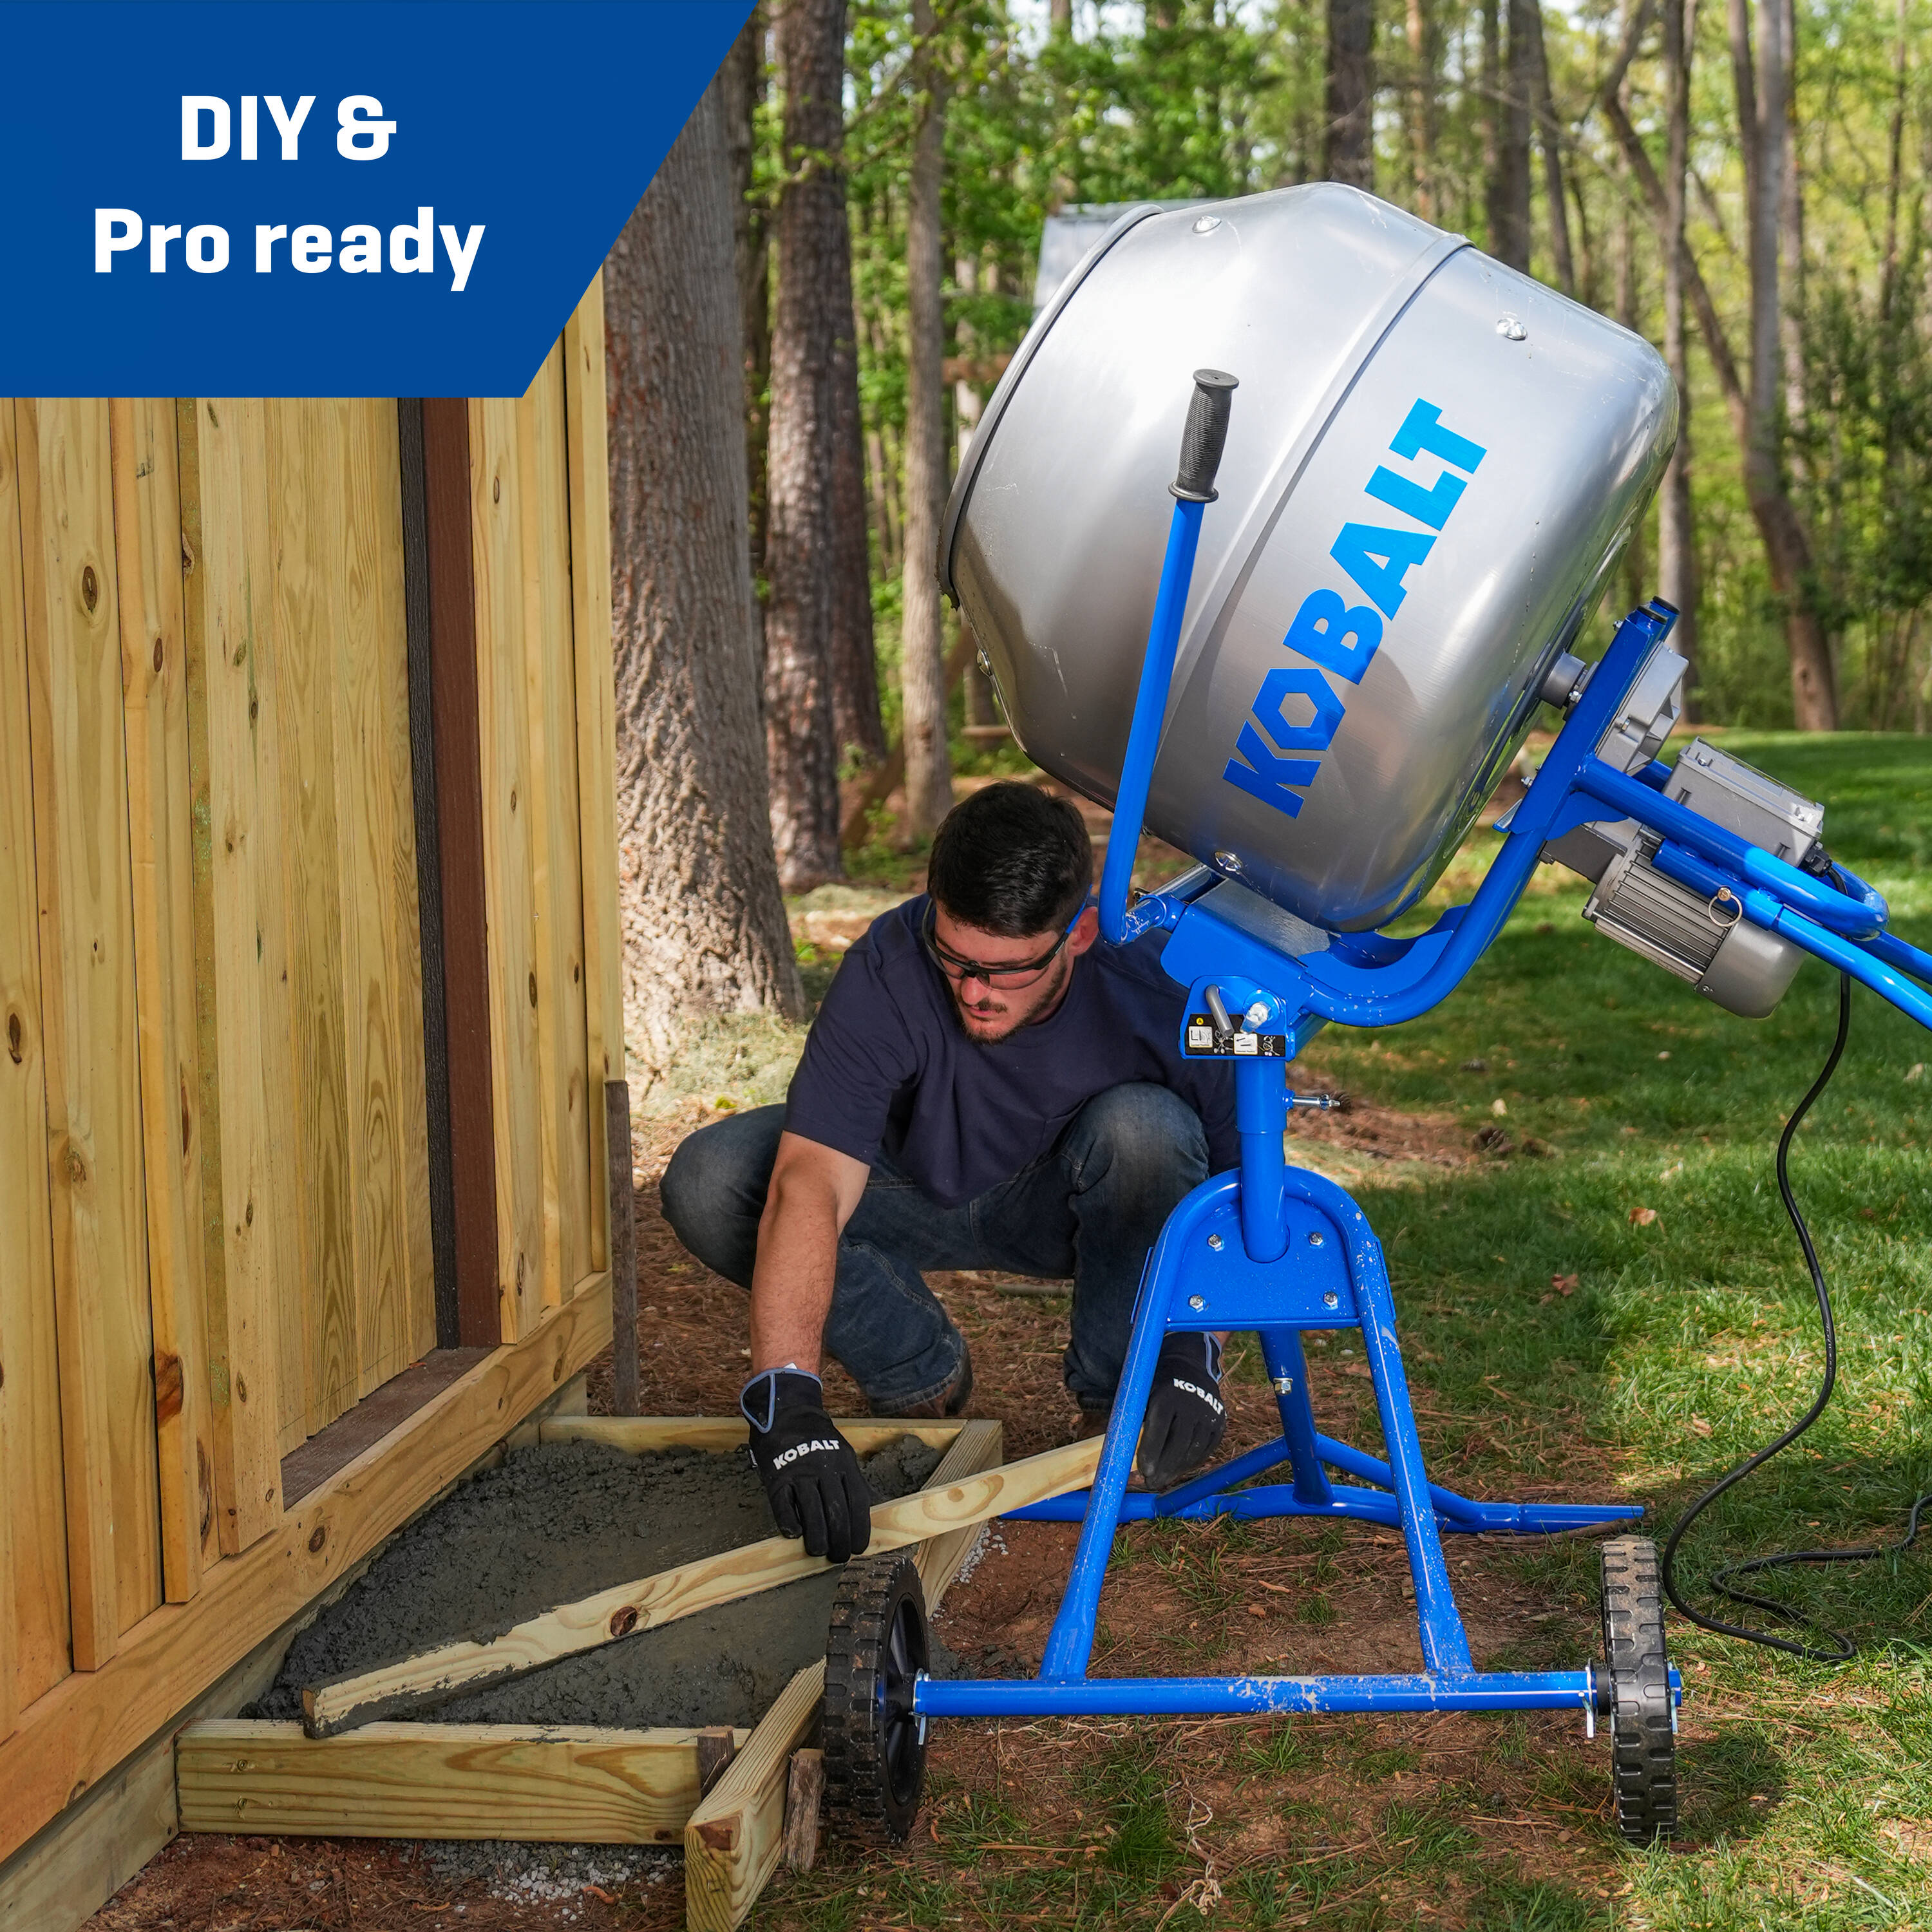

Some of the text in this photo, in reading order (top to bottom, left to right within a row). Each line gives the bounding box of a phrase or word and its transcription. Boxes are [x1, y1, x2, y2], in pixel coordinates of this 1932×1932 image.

[1222, 397, 1487, 819] KOBALT
[1173, 1378, 1224, 1416] KOBALT
[773, 1439, 840, 1470] KOBALT
